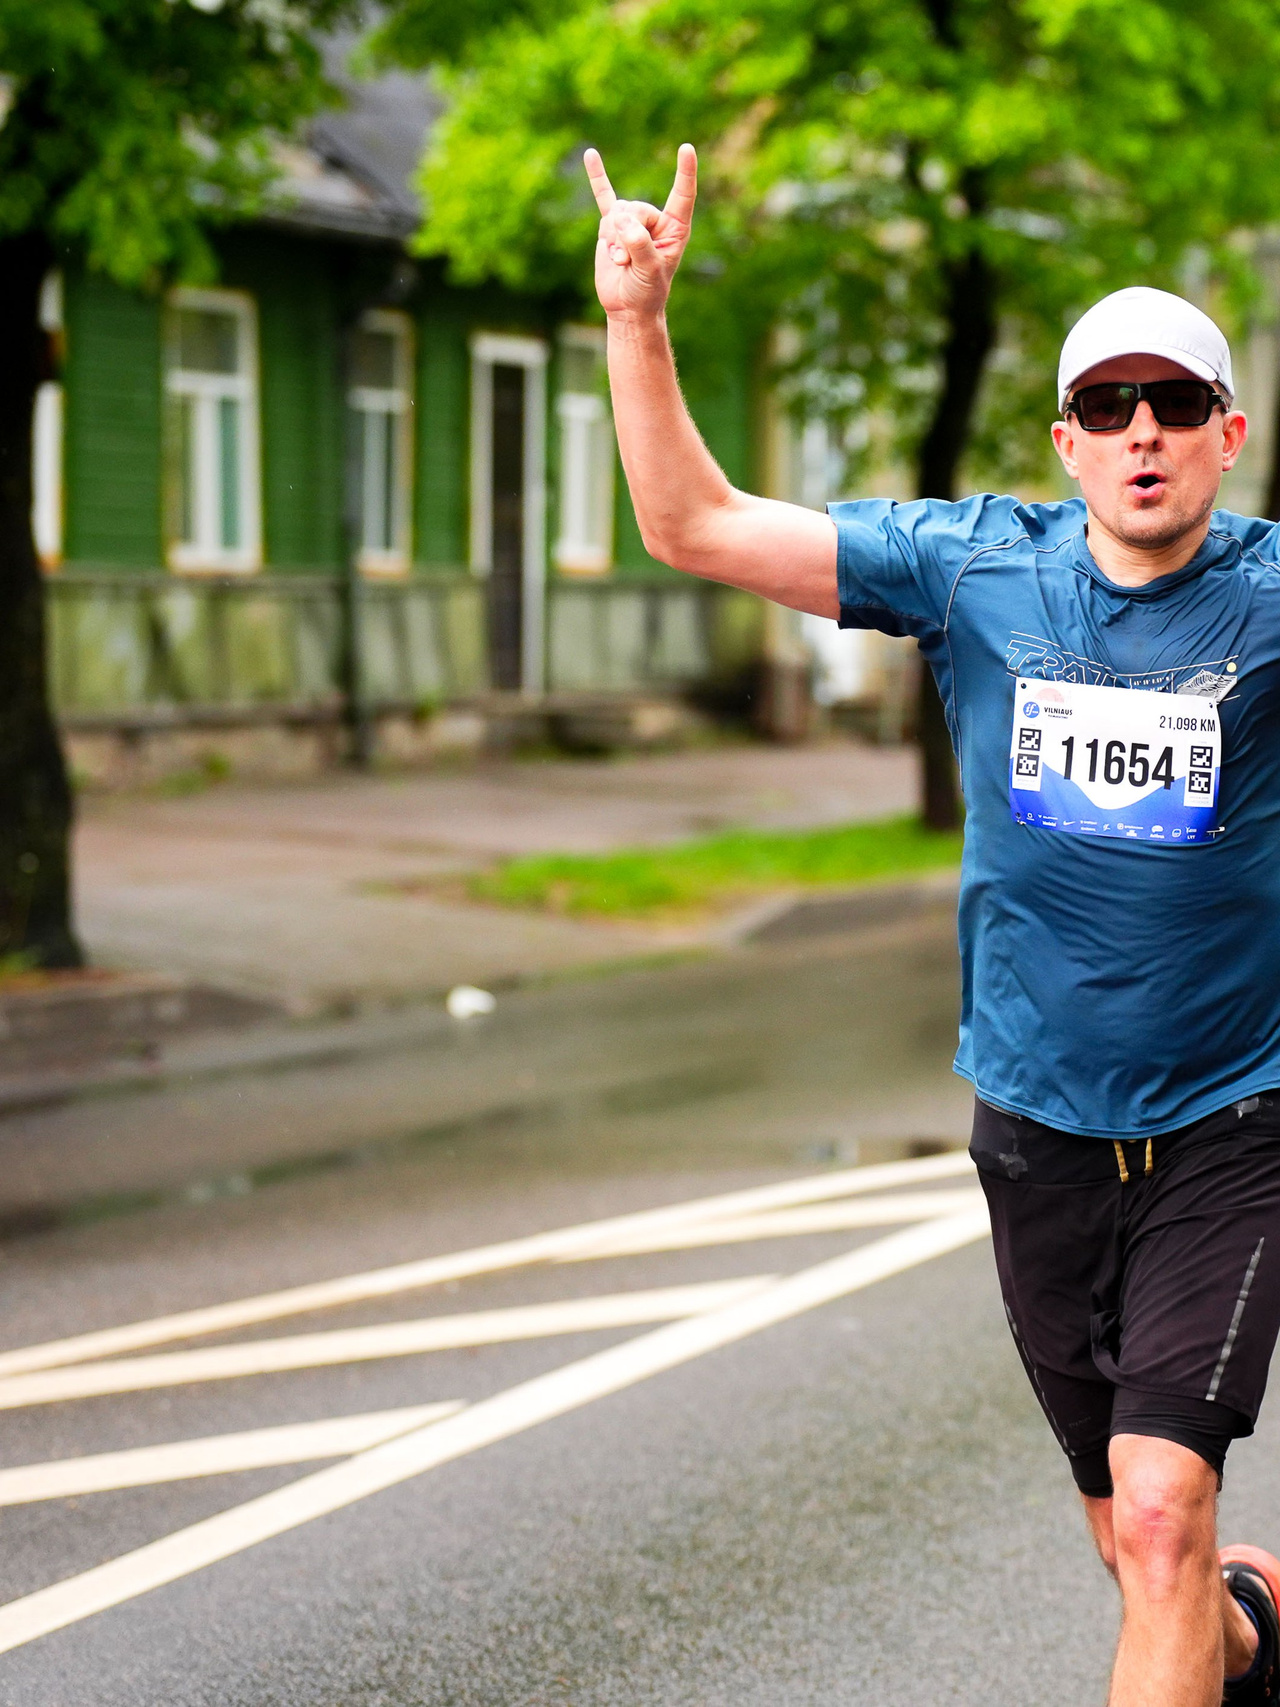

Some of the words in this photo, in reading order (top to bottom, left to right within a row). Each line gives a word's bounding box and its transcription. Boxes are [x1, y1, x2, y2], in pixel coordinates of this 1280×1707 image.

[1043, 706, 1073, 716] VILNIAUS
[1200, 718, 1216, 732] KM
[1061, 736, 1175, 790] 11654
